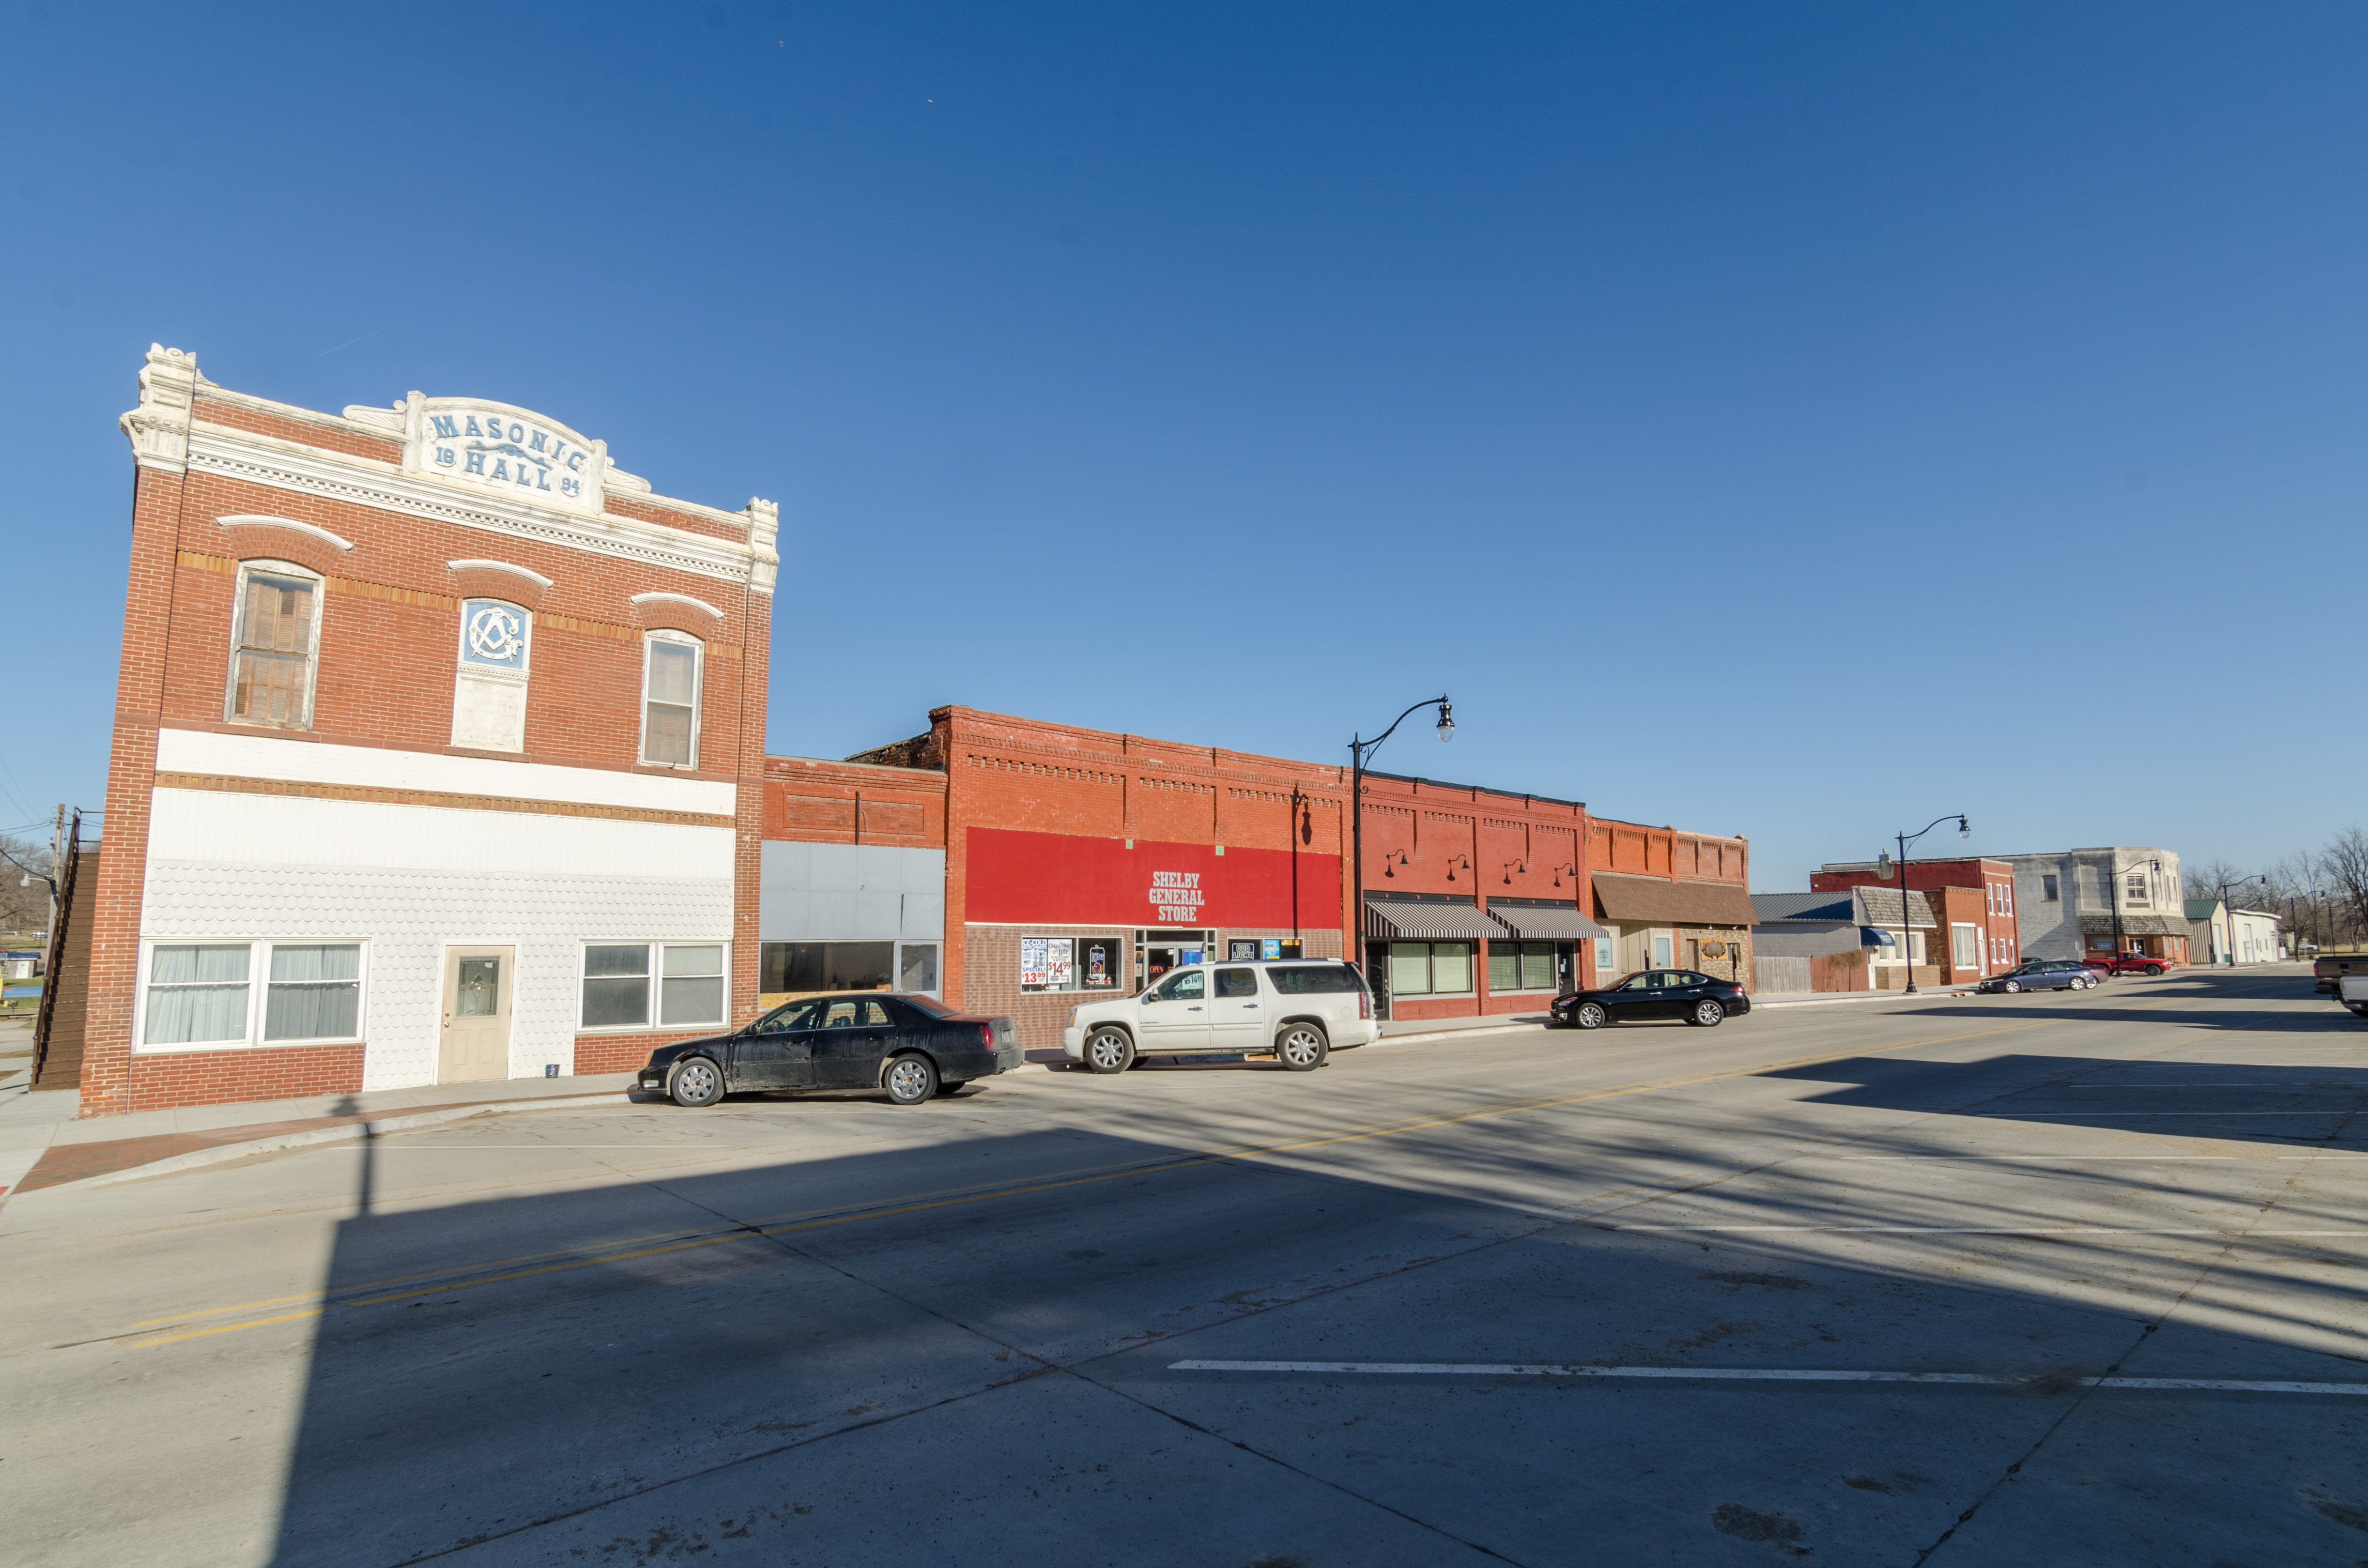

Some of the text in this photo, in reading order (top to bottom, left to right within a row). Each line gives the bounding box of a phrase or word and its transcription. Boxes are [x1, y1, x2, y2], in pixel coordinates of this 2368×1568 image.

[431, 414, 586, 472] MASONIC
[436, 446, 581, 494] 18 HALL 94
[1153, 871, 1200, 889] SHELBY
[1149, 888, 1205, 906] GENERAL
[1158, 905, 1197, 922] STORE
[1091, 952, 1104, 962] Lite
[1233, 951, 1253, 959] LIGHT
